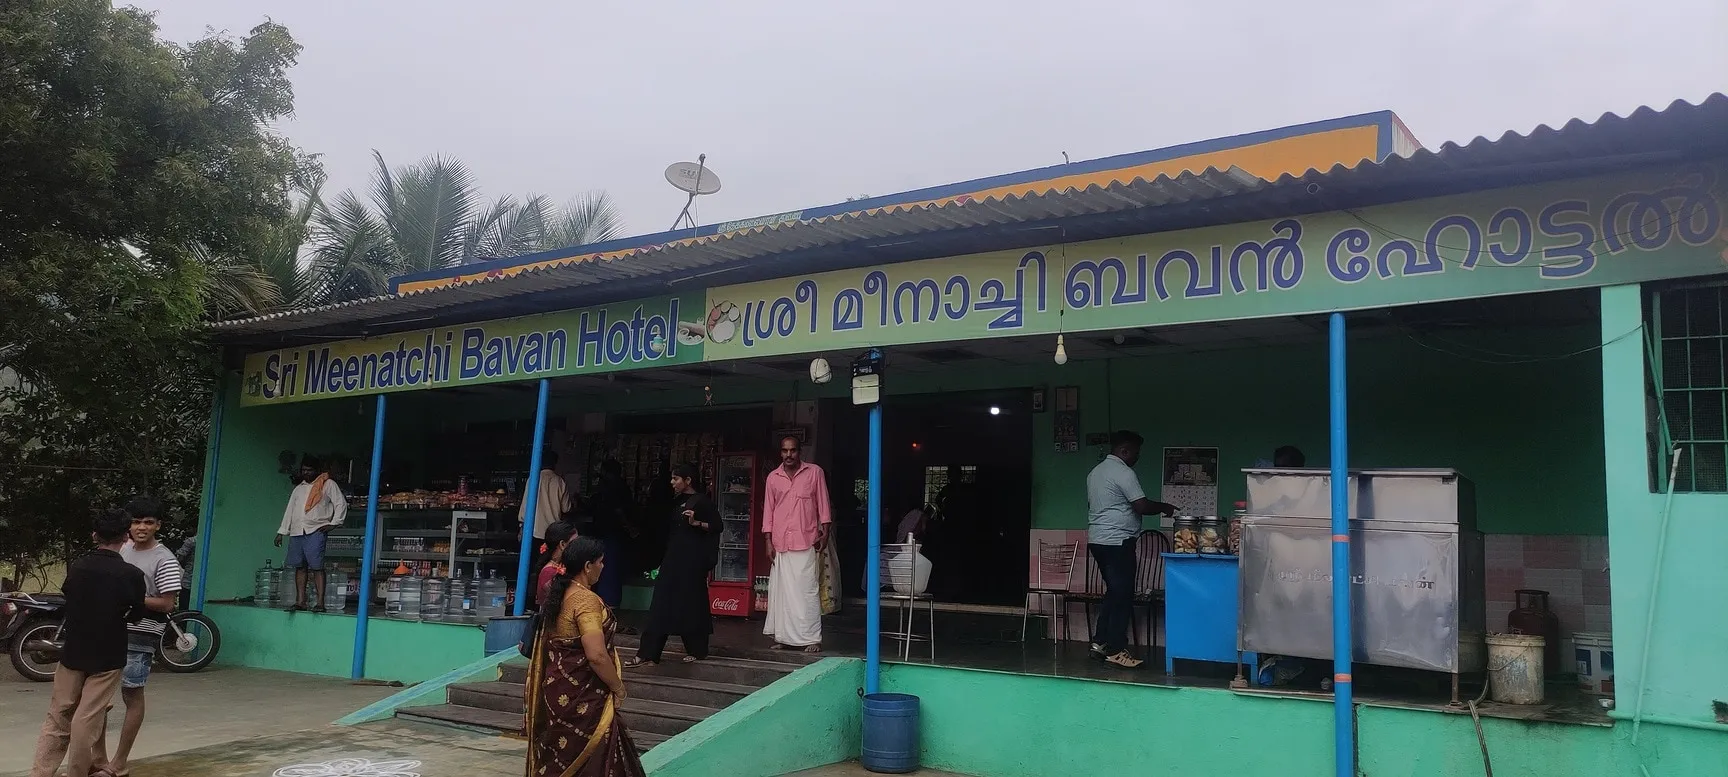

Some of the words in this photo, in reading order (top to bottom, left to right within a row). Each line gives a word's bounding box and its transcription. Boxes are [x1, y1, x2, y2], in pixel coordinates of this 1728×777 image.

[742, 279, 818, 348] ശ്രീ
[832, 250, 1048, 331] മീനാച്ചി
[1063, 218, 1305, 310] ബവൻ
[1325, 163, 1723, 283] ഹോട്ടൽ
[262, 346, 299, 400] Sri
[302, 329, 452, 396] Meenatchi
[458, 327, 568, 381] Bavan
[575, 297, 681, 368] Hotel
[712, 597, 740, 611] Coca-Cola
